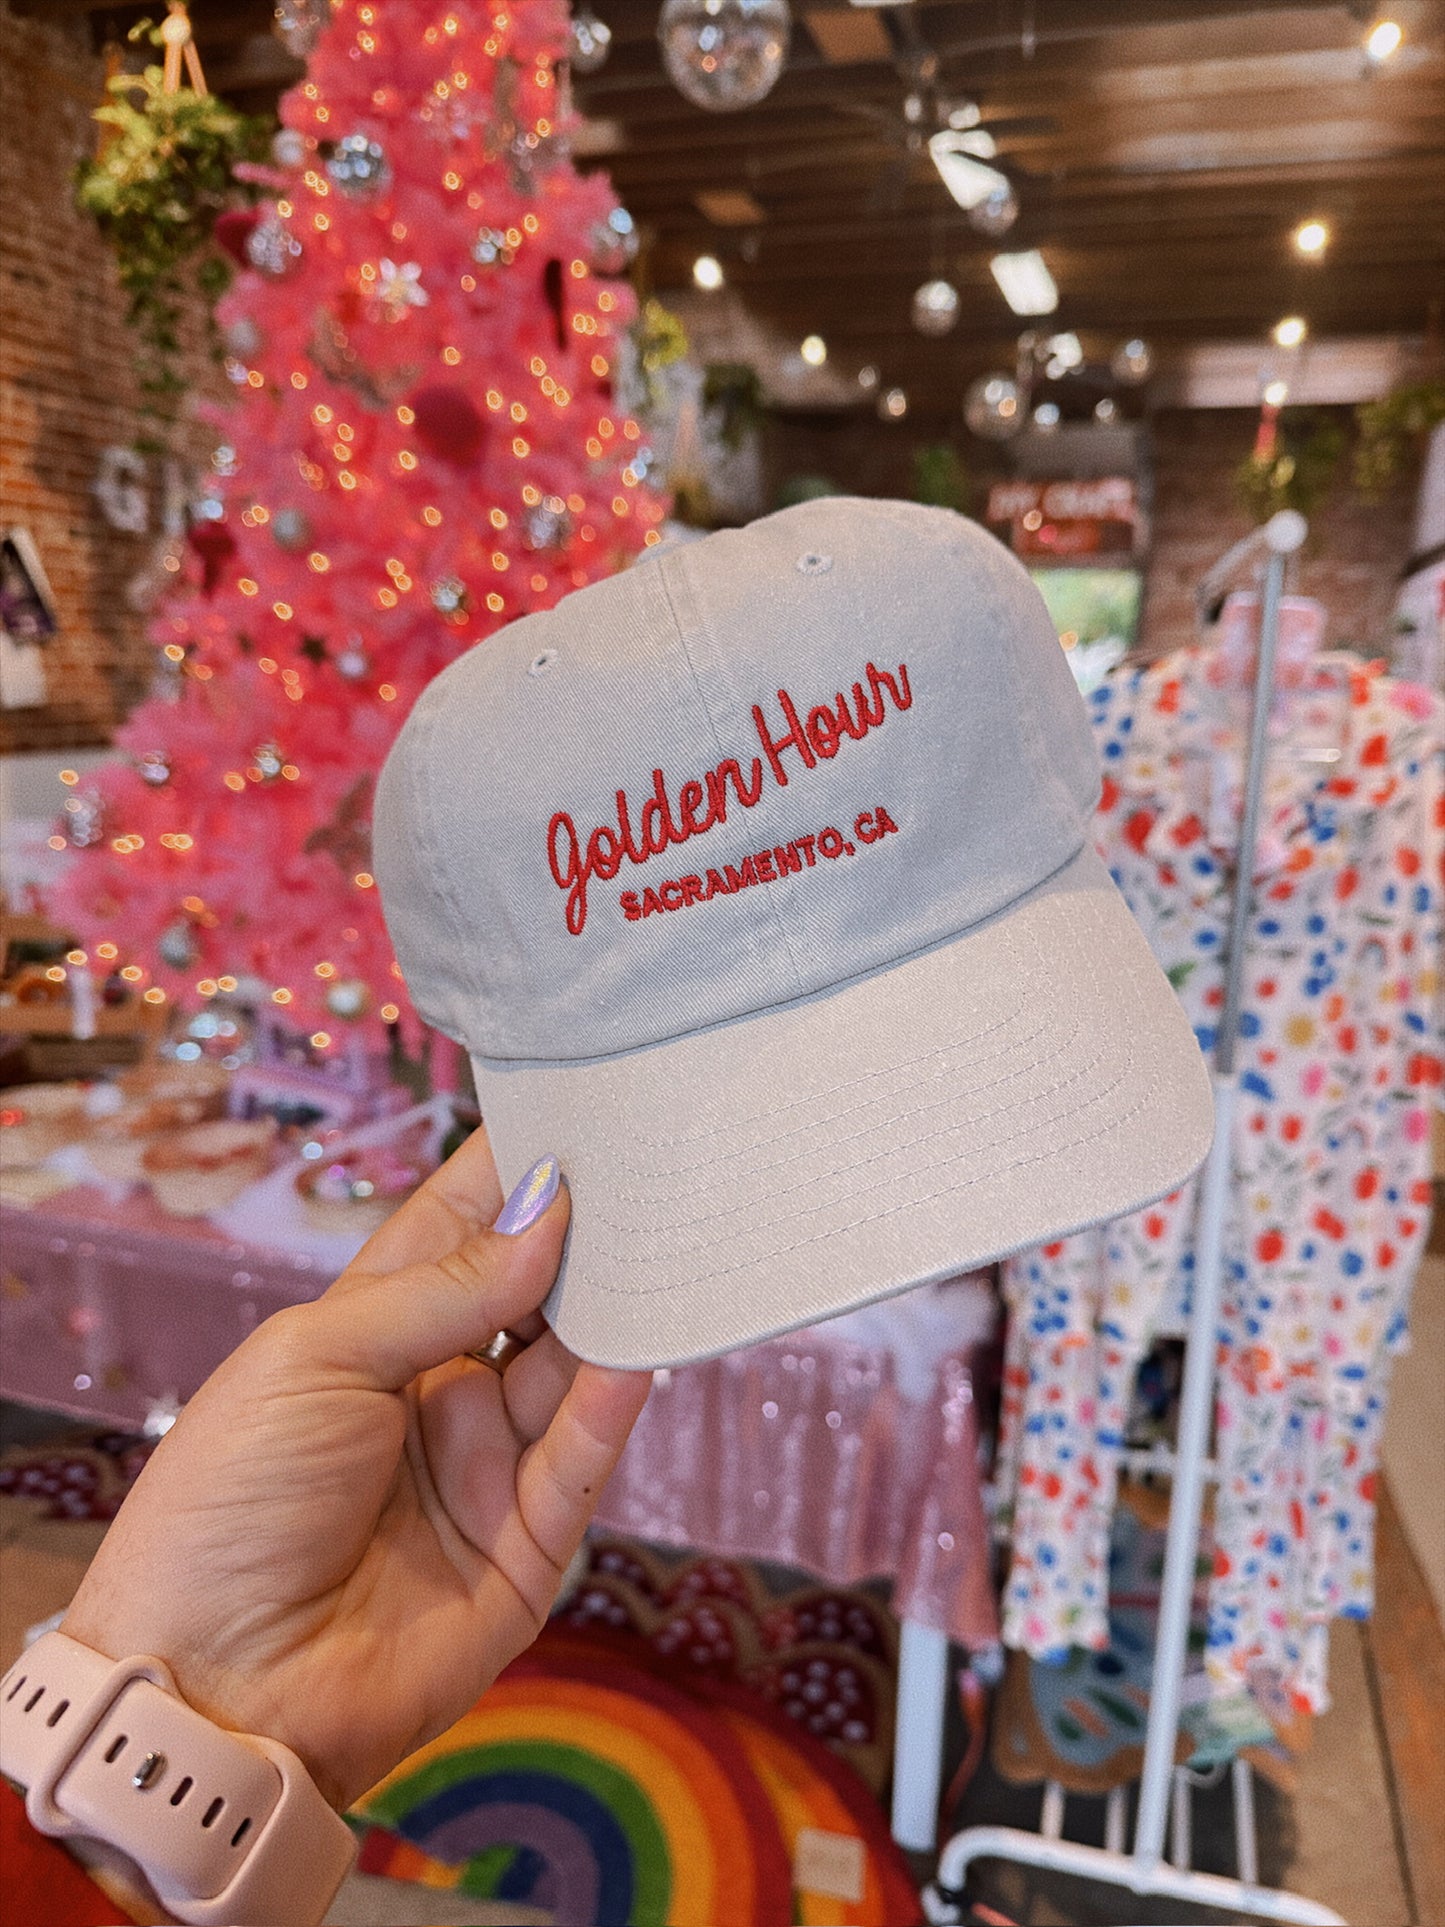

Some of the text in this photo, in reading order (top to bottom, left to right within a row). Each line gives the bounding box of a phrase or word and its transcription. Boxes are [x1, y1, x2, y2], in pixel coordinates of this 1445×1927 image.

[546, 661, 913, 936] Golden Hour
[619, 806, 899, 922] SACRAMENTO, CA
